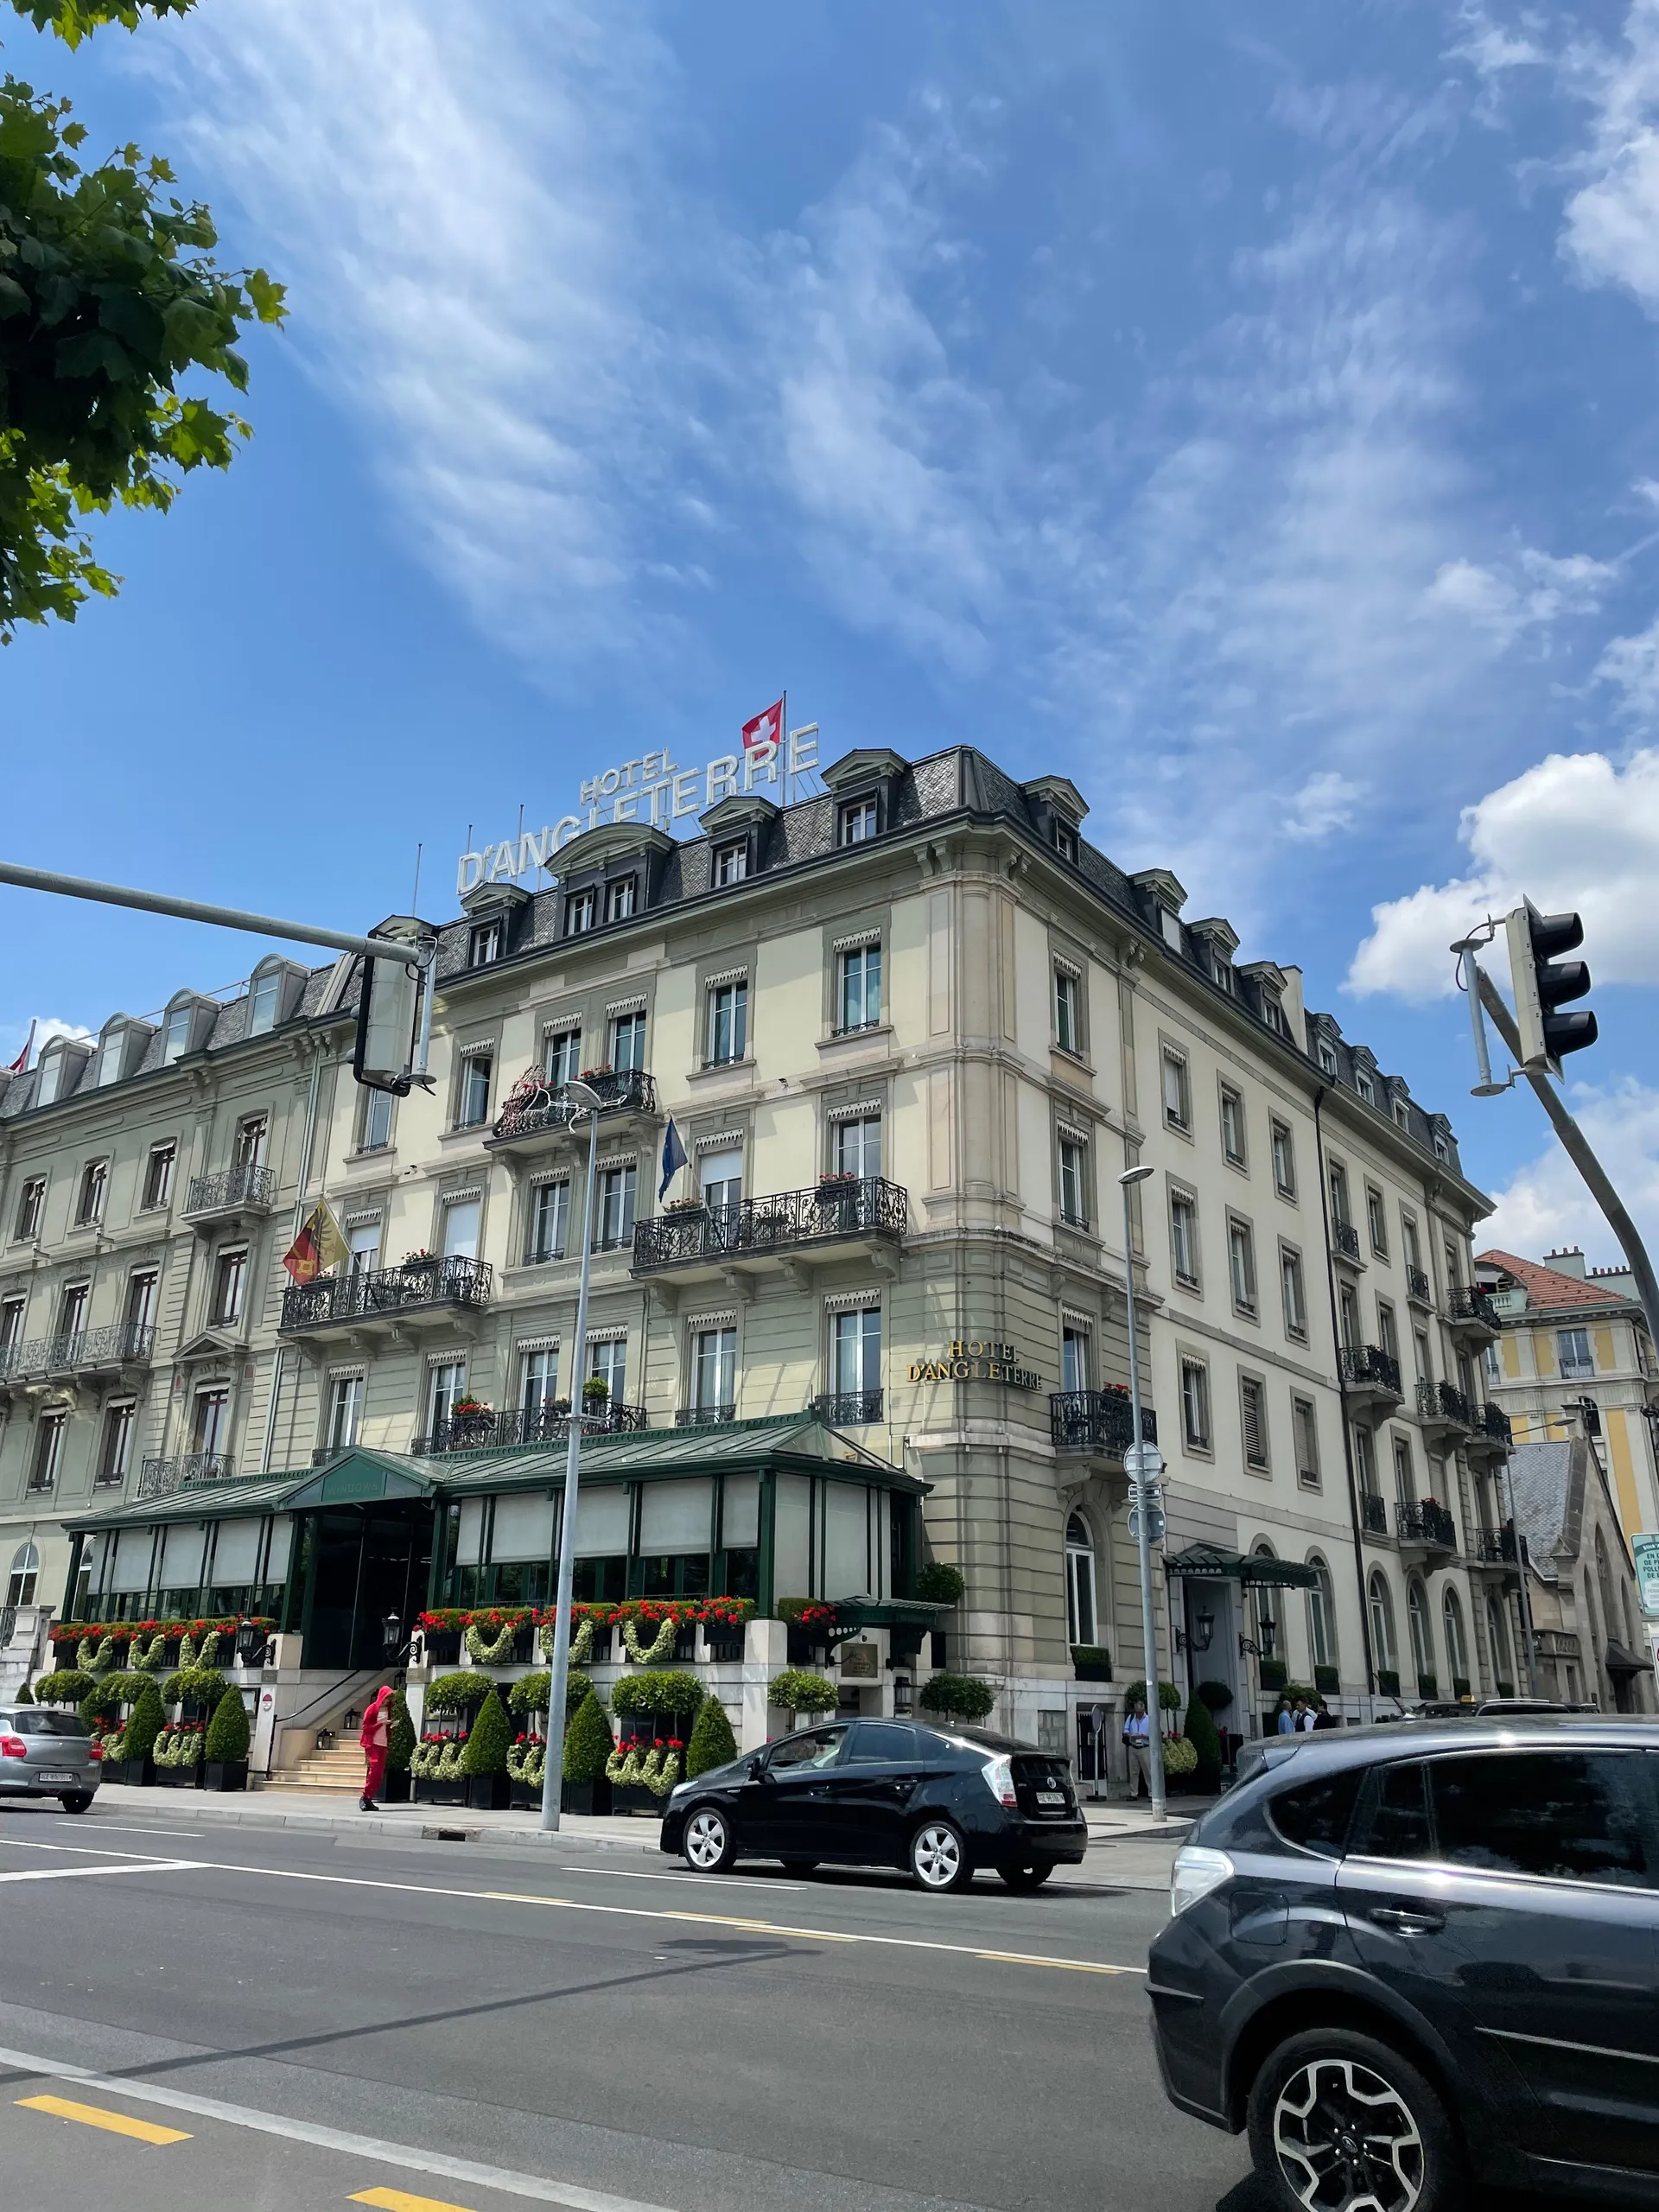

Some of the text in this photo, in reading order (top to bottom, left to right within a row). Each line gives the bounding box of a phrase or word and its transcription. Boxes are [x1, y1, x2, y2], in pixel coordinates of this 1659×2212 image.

[580, 747, 679, 805] HOTEL
[949, 1340, 1020, 1363] HOTEL
[907, 1361, 1043, 1390] D'ANGLETERRE
